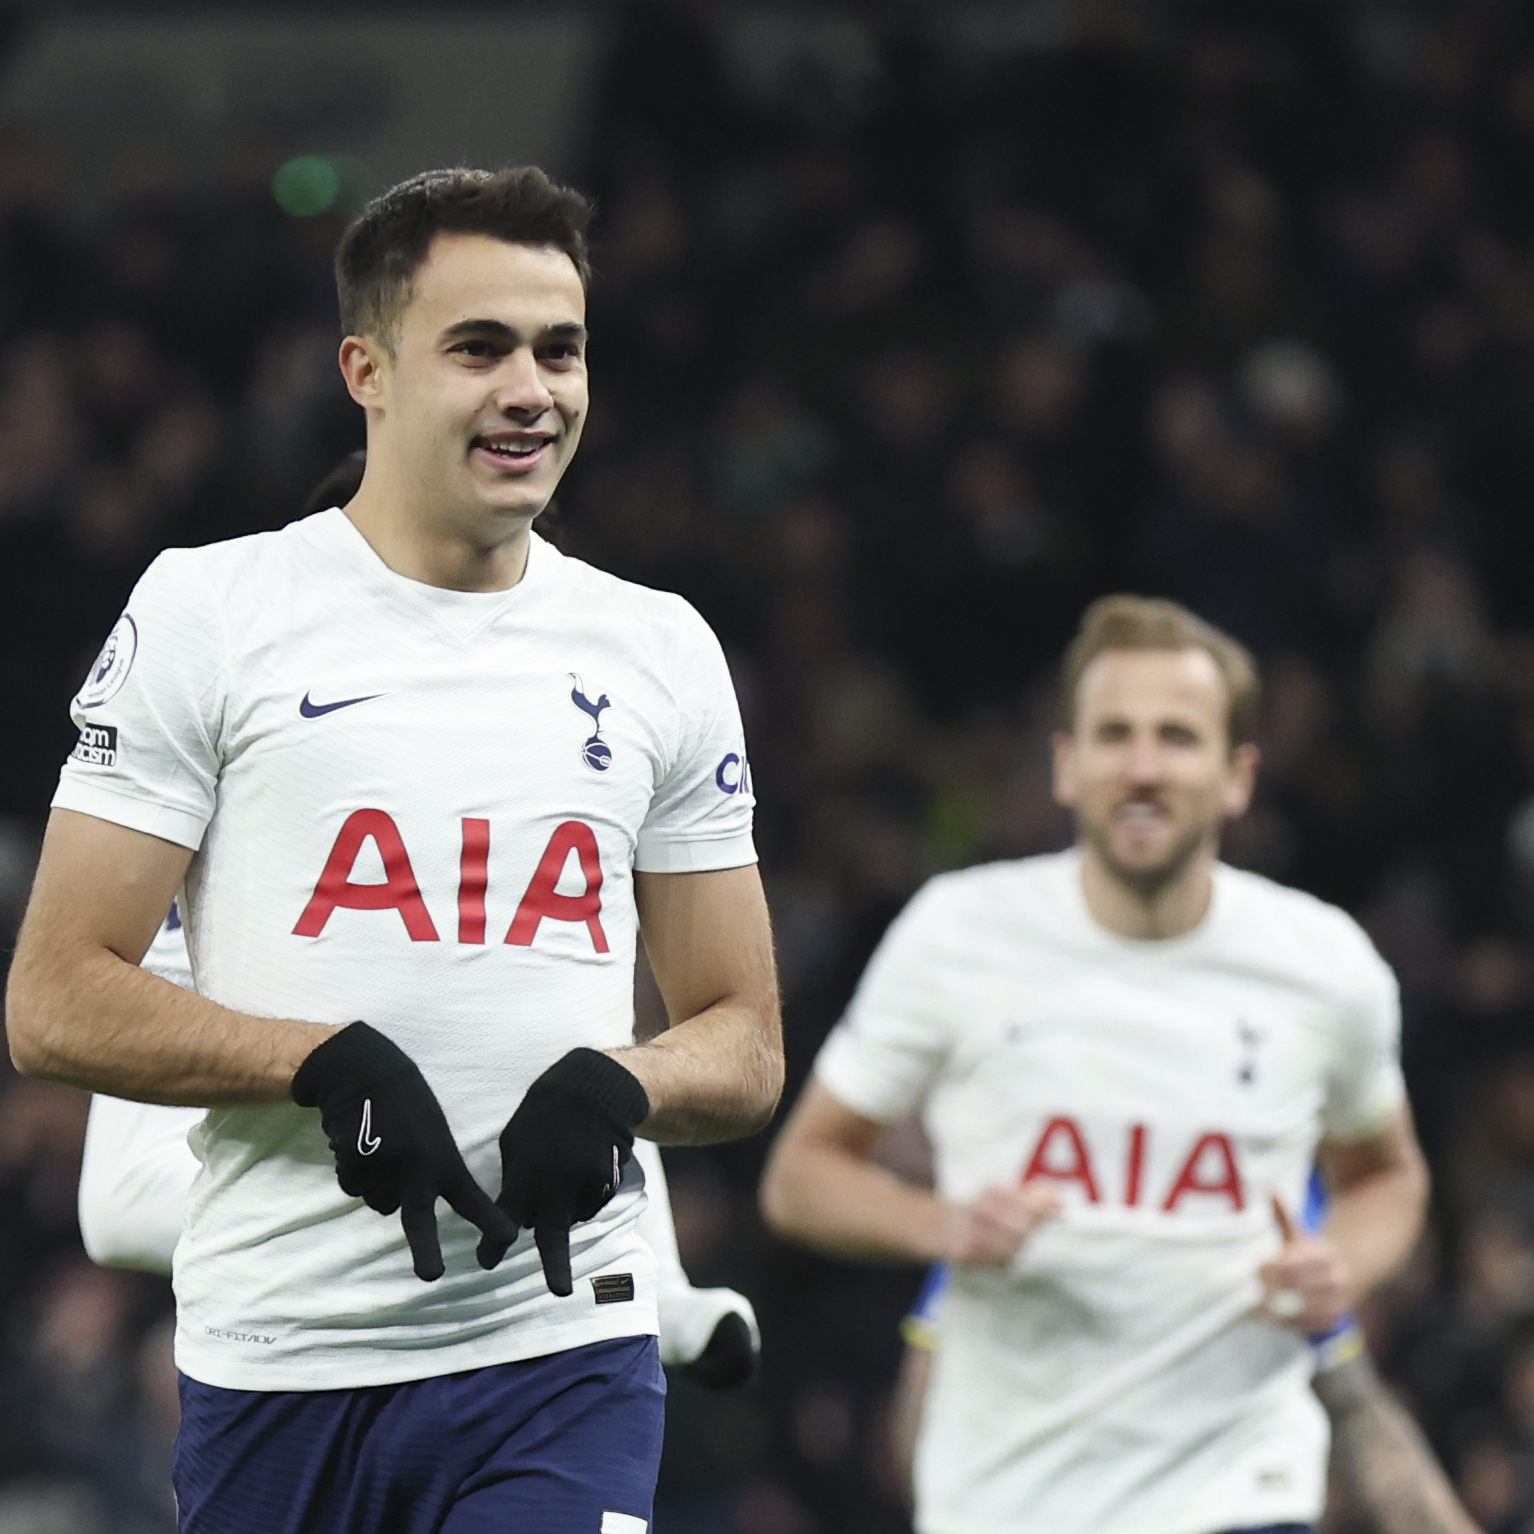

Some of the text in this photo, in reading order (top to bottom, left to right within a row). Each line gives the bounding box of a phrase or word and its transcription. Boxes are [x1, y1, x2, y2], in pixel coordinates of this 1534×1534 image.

[71, 742, 116, 767] acism
[290, 807, 611, 954] AIA
[1020, 1115, 1246, 1214] AIA
